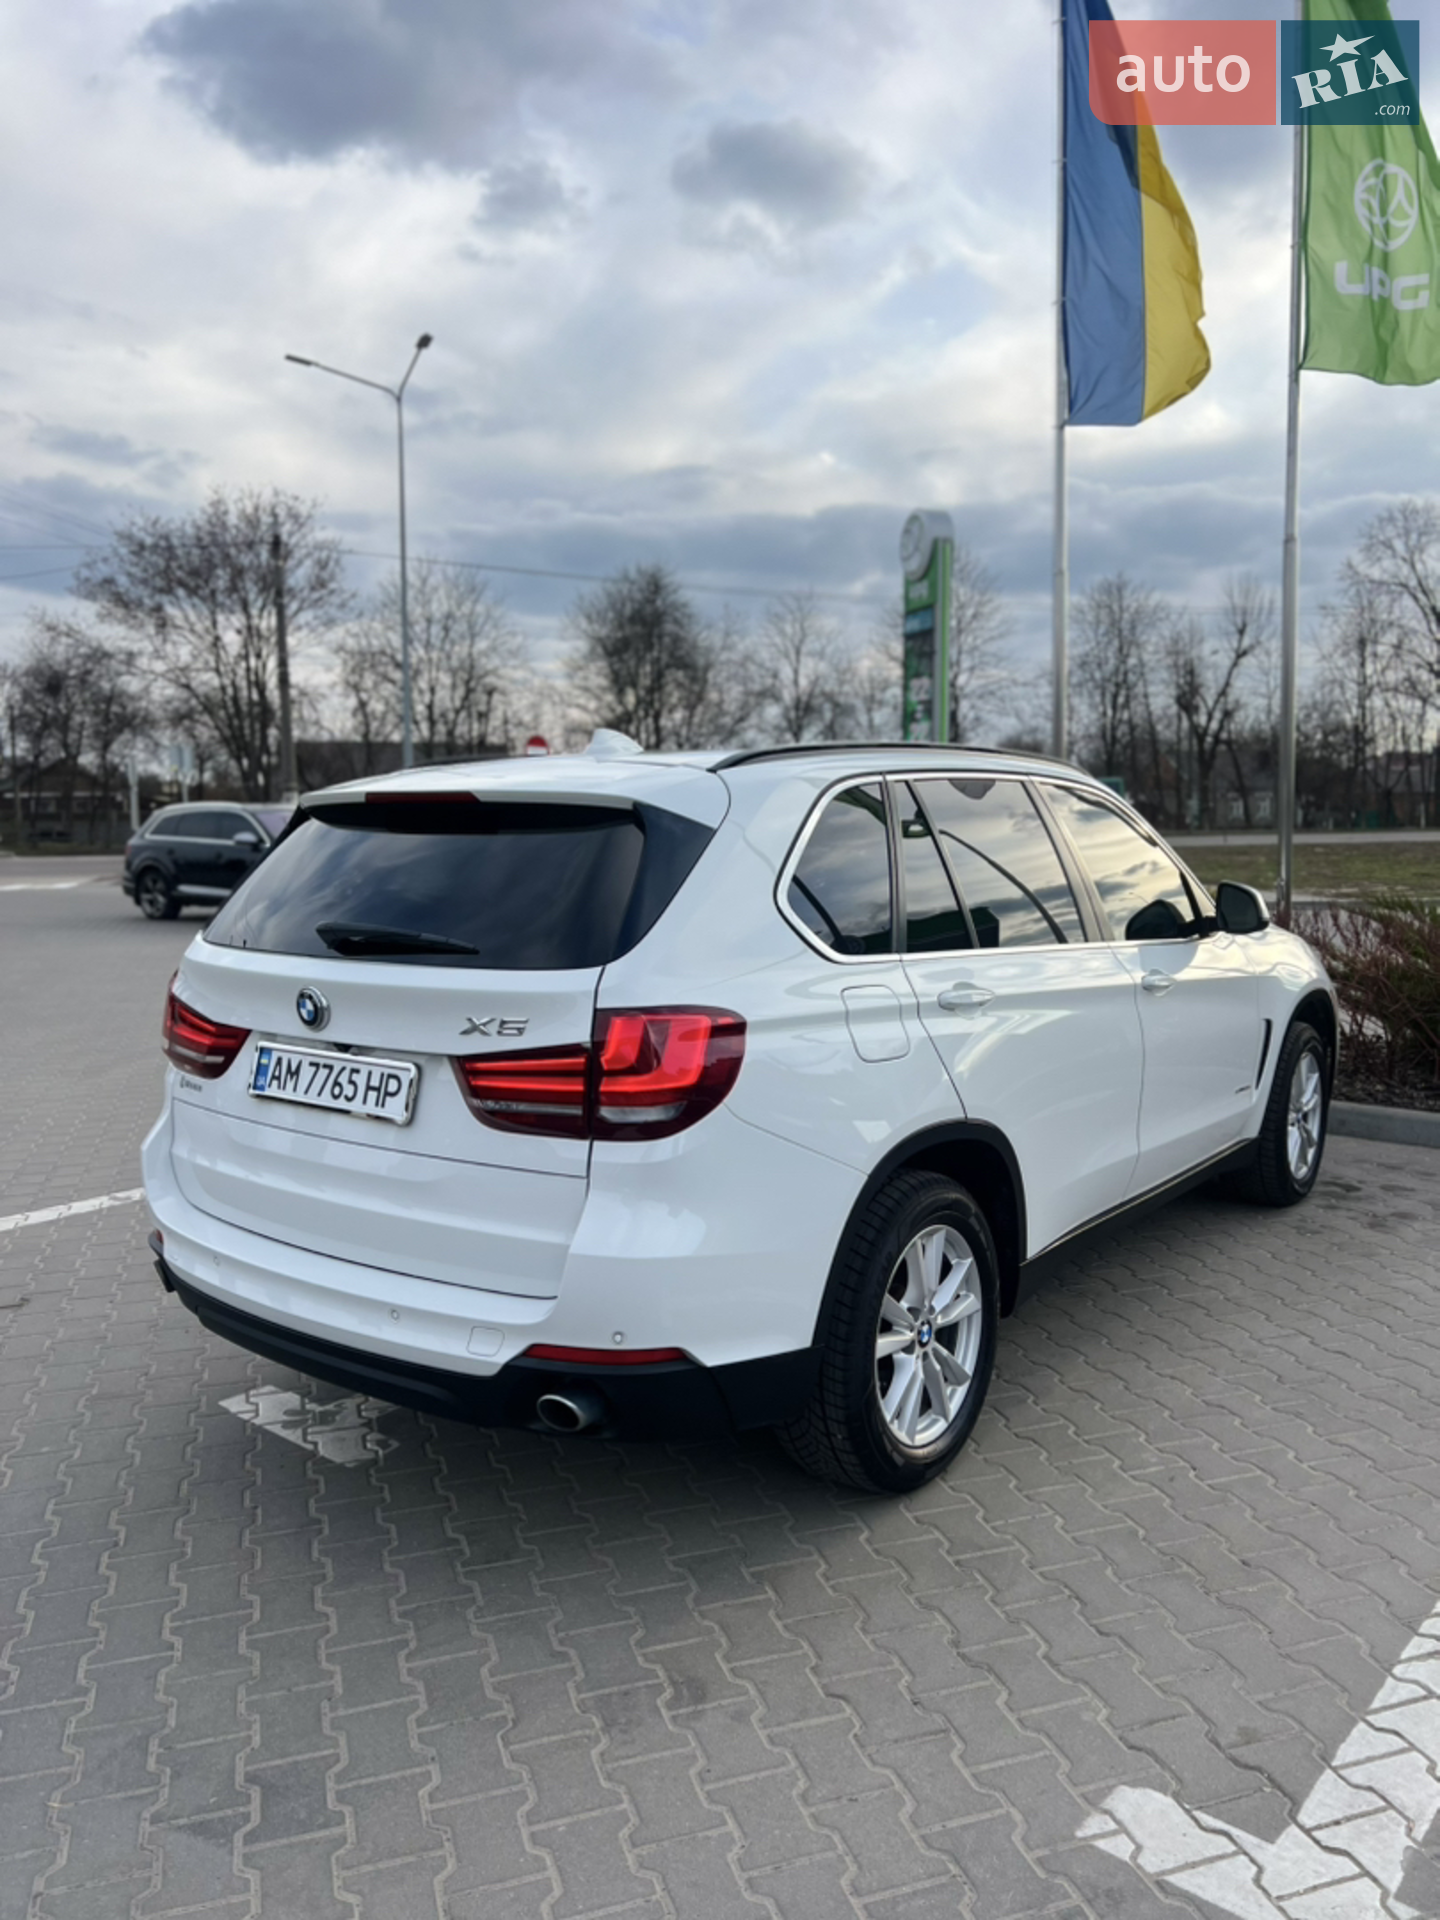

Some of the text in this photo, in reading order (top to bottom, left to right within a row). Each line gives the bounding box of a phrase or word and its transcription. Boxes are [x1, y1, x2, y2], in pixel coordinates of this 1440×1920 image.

[459, 1016, 530, 1037] X5
[268, 1056, 402, 1109] AM 7765 HP
